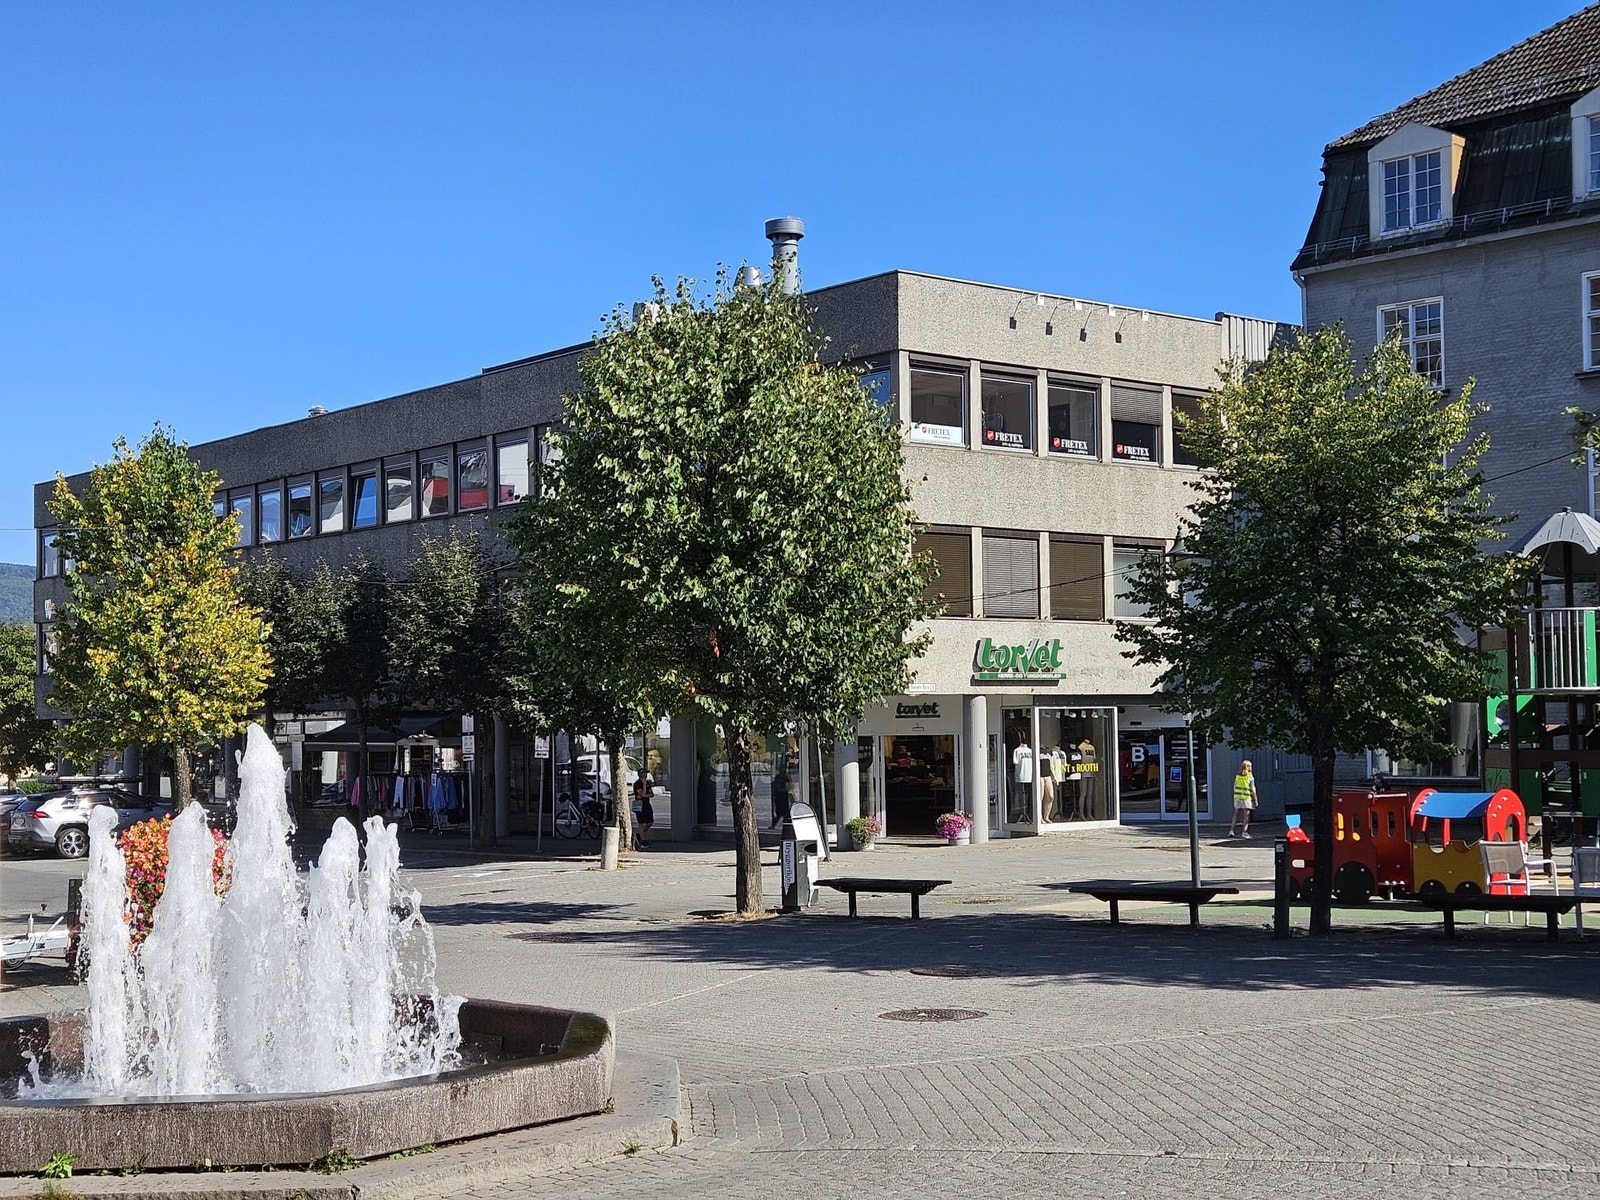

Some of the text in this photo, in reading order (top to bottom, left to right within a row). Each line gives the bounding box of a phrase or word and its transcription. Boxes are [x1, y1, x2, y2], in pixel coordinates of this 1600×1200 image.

[927, 427, 951, 437] FRETEX
[995, 431, 1023, 443] FRETEX
[1061, 438, 1088, 450] FRETEX
[1123, 445, 1150, 457] FRETEX
[979, 637, 1064, 674] torvet
[896, 702, 940, 715] torvet
[1131, 747, 1145, 762] B
[1076, 763, 1099, 773] ROOTH
